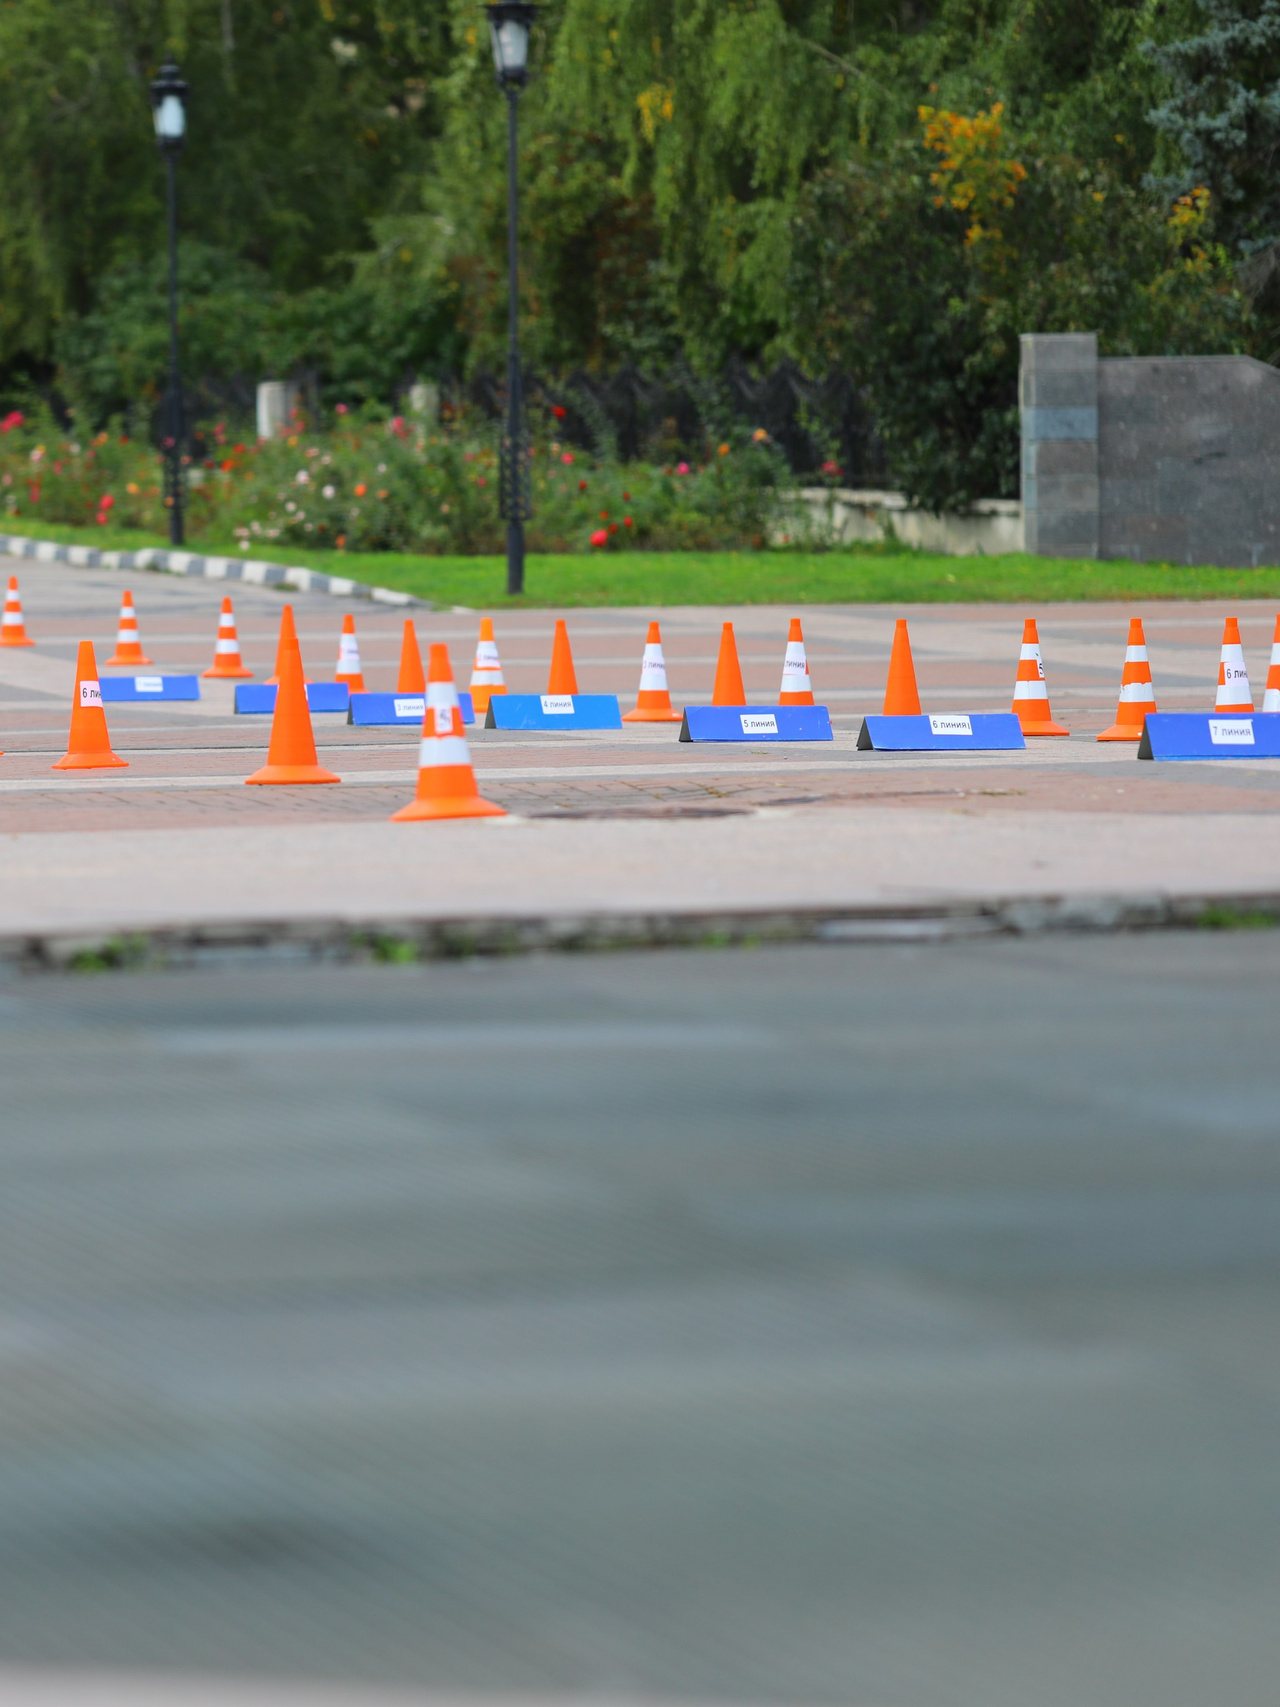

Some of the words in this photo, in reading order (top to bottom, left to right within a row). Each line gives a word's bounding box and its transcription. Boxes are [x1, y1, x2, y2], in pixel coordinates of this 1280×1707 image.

[1226, 668, 1231, 679] 6
[82, 687, 88, 698] 6
[743, 720, 749, 728] 5
[751, 720, 776, 728] линия
[932, 720, 938, 729] 6
[940, 721, 967, 729] линия
[1213, 726, 1218, 736] 7
[1221, 727, 1252, 737] линия
